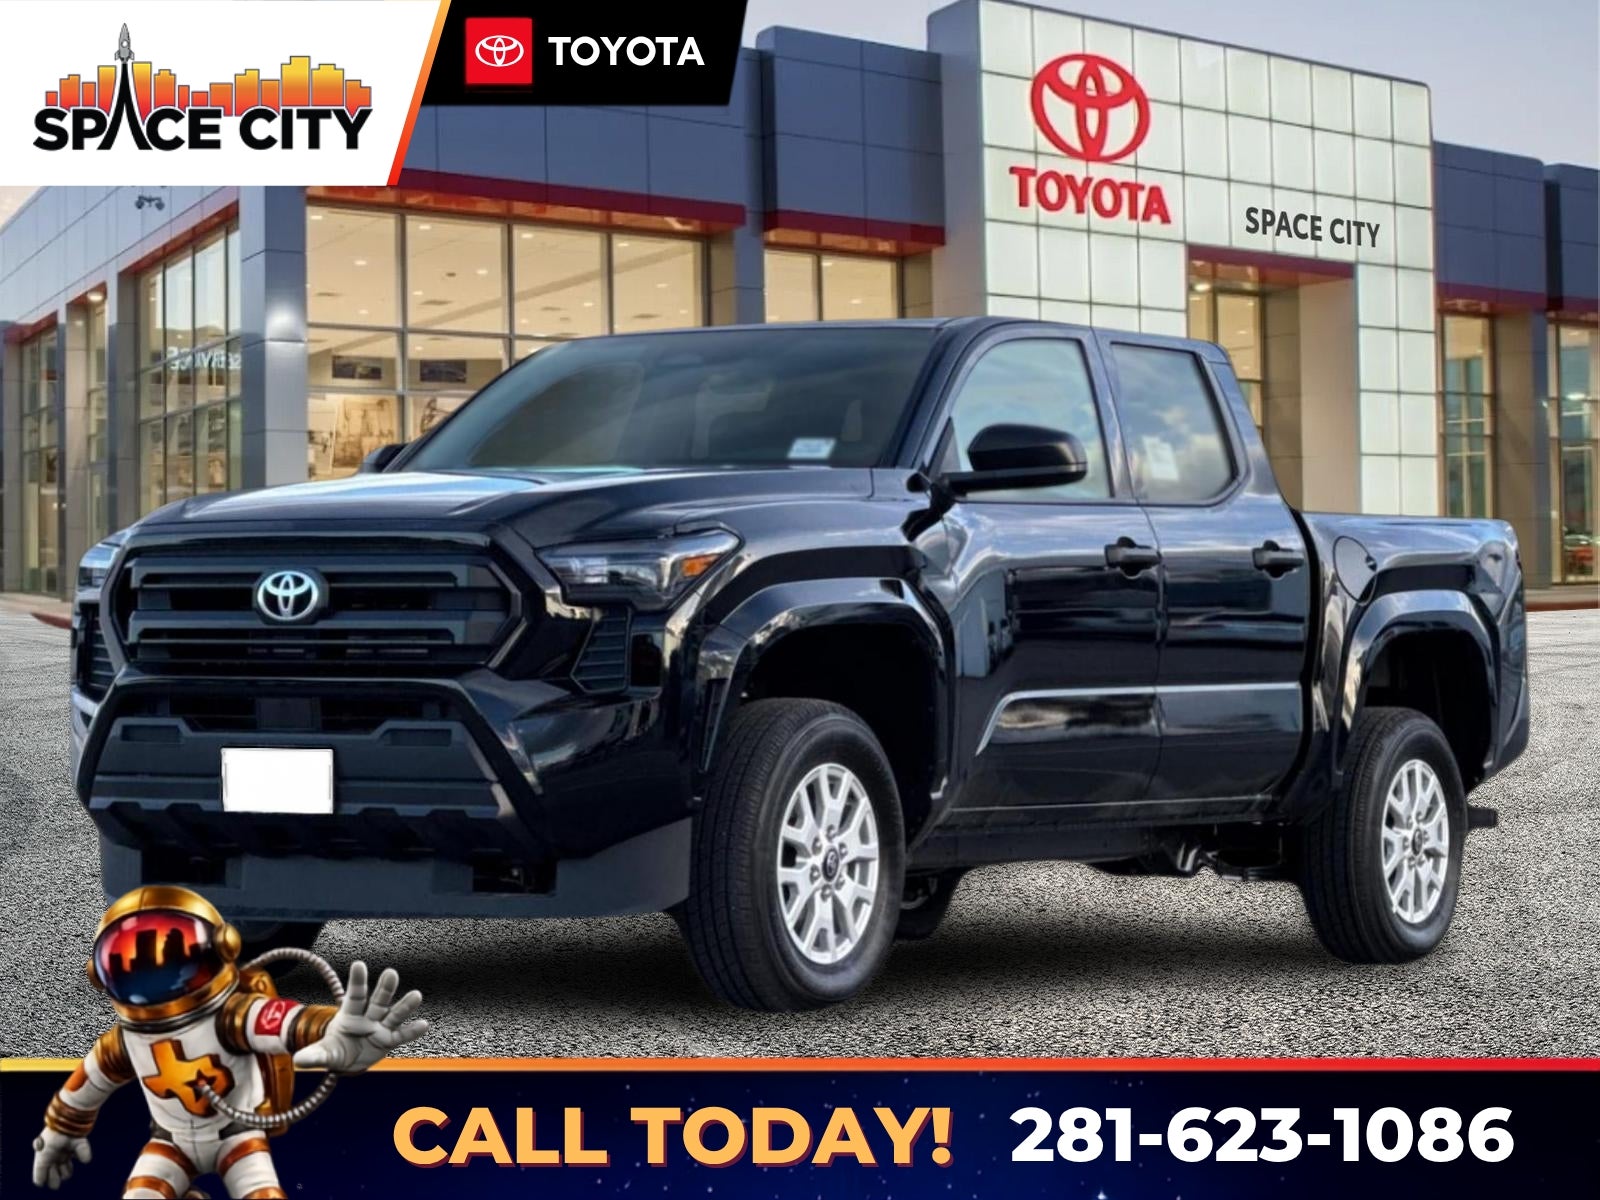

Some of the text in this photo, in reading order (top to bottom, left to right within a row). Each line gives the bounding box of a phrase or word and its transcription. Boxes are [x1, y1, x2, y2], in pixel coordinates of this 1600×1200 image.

[1009, 166, 1171, 224] TOYOTA
[1245, 206, 1381, 248] SPACE CITY
